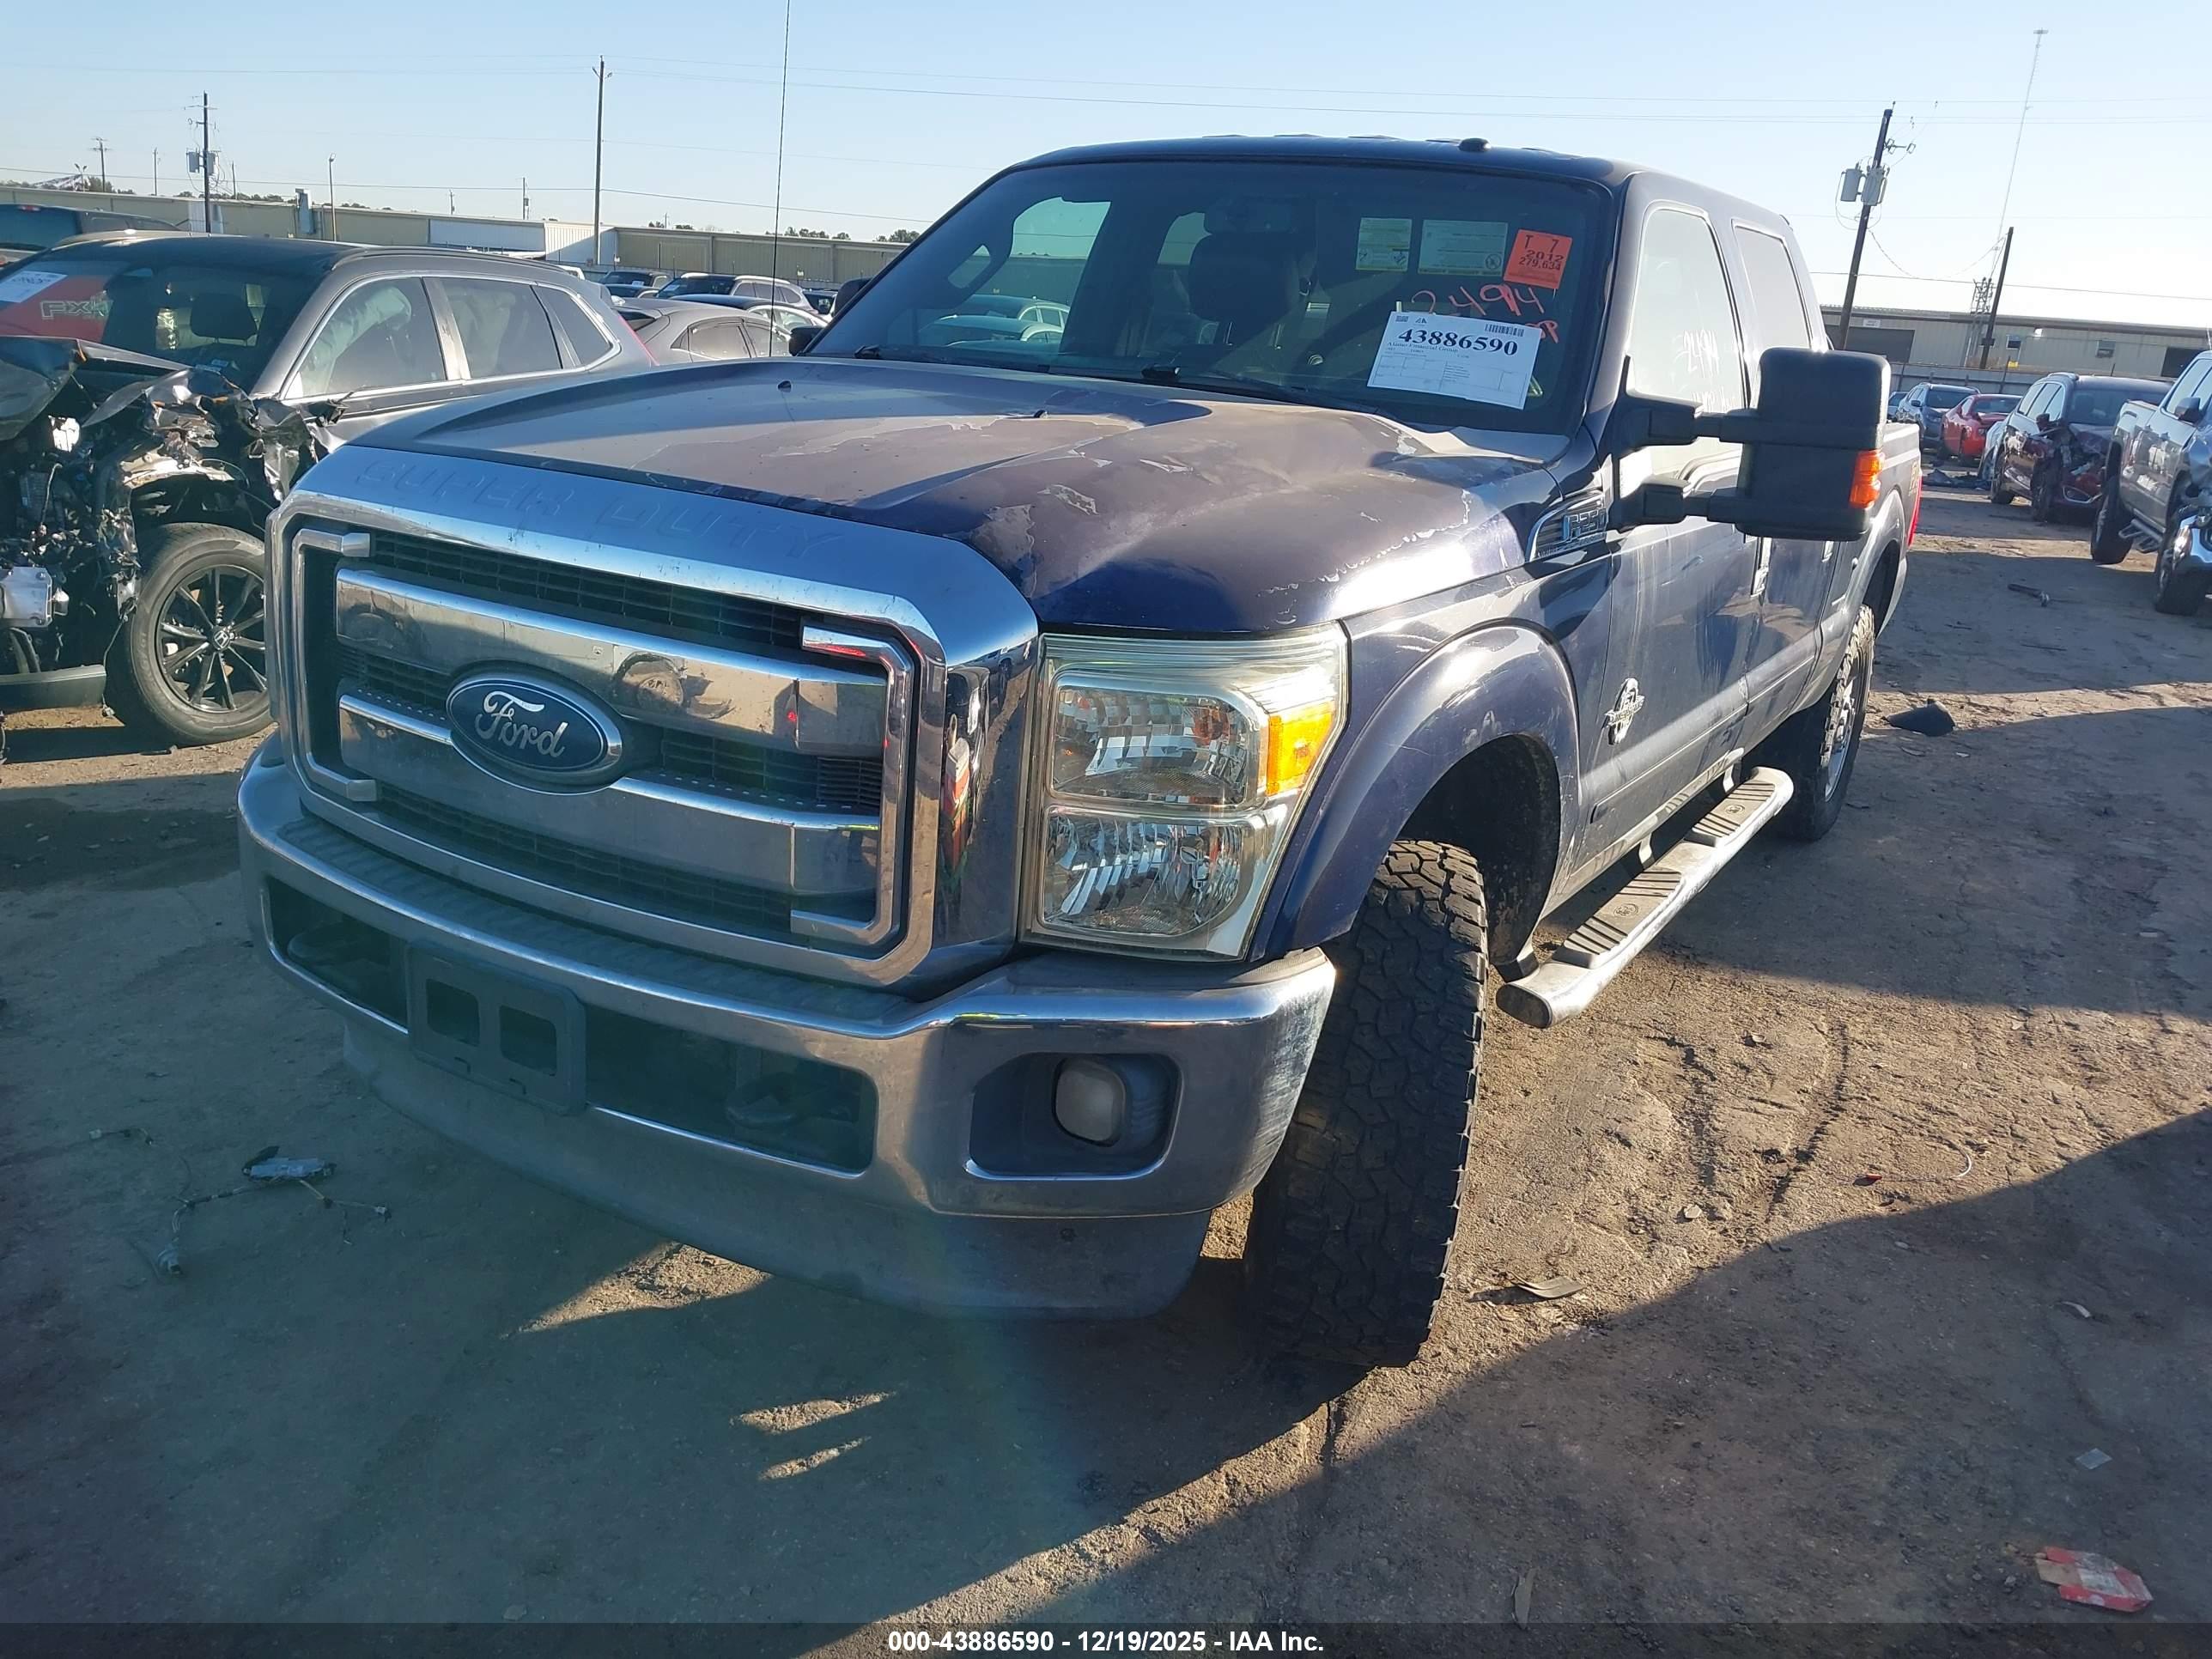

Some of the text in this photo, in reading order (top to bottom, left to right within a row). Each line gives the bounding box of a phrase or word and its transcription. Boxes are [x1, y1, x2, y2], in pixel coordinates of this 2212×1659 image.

[1524, 234, 1559, 253] T 7
[1526, 249, 1565, 263] 2012
[1398, 328, 1518, 356] 43886590
[354, 458, 847, 561] SUPER DUTY
[475, 690, 568, 757] Ford
